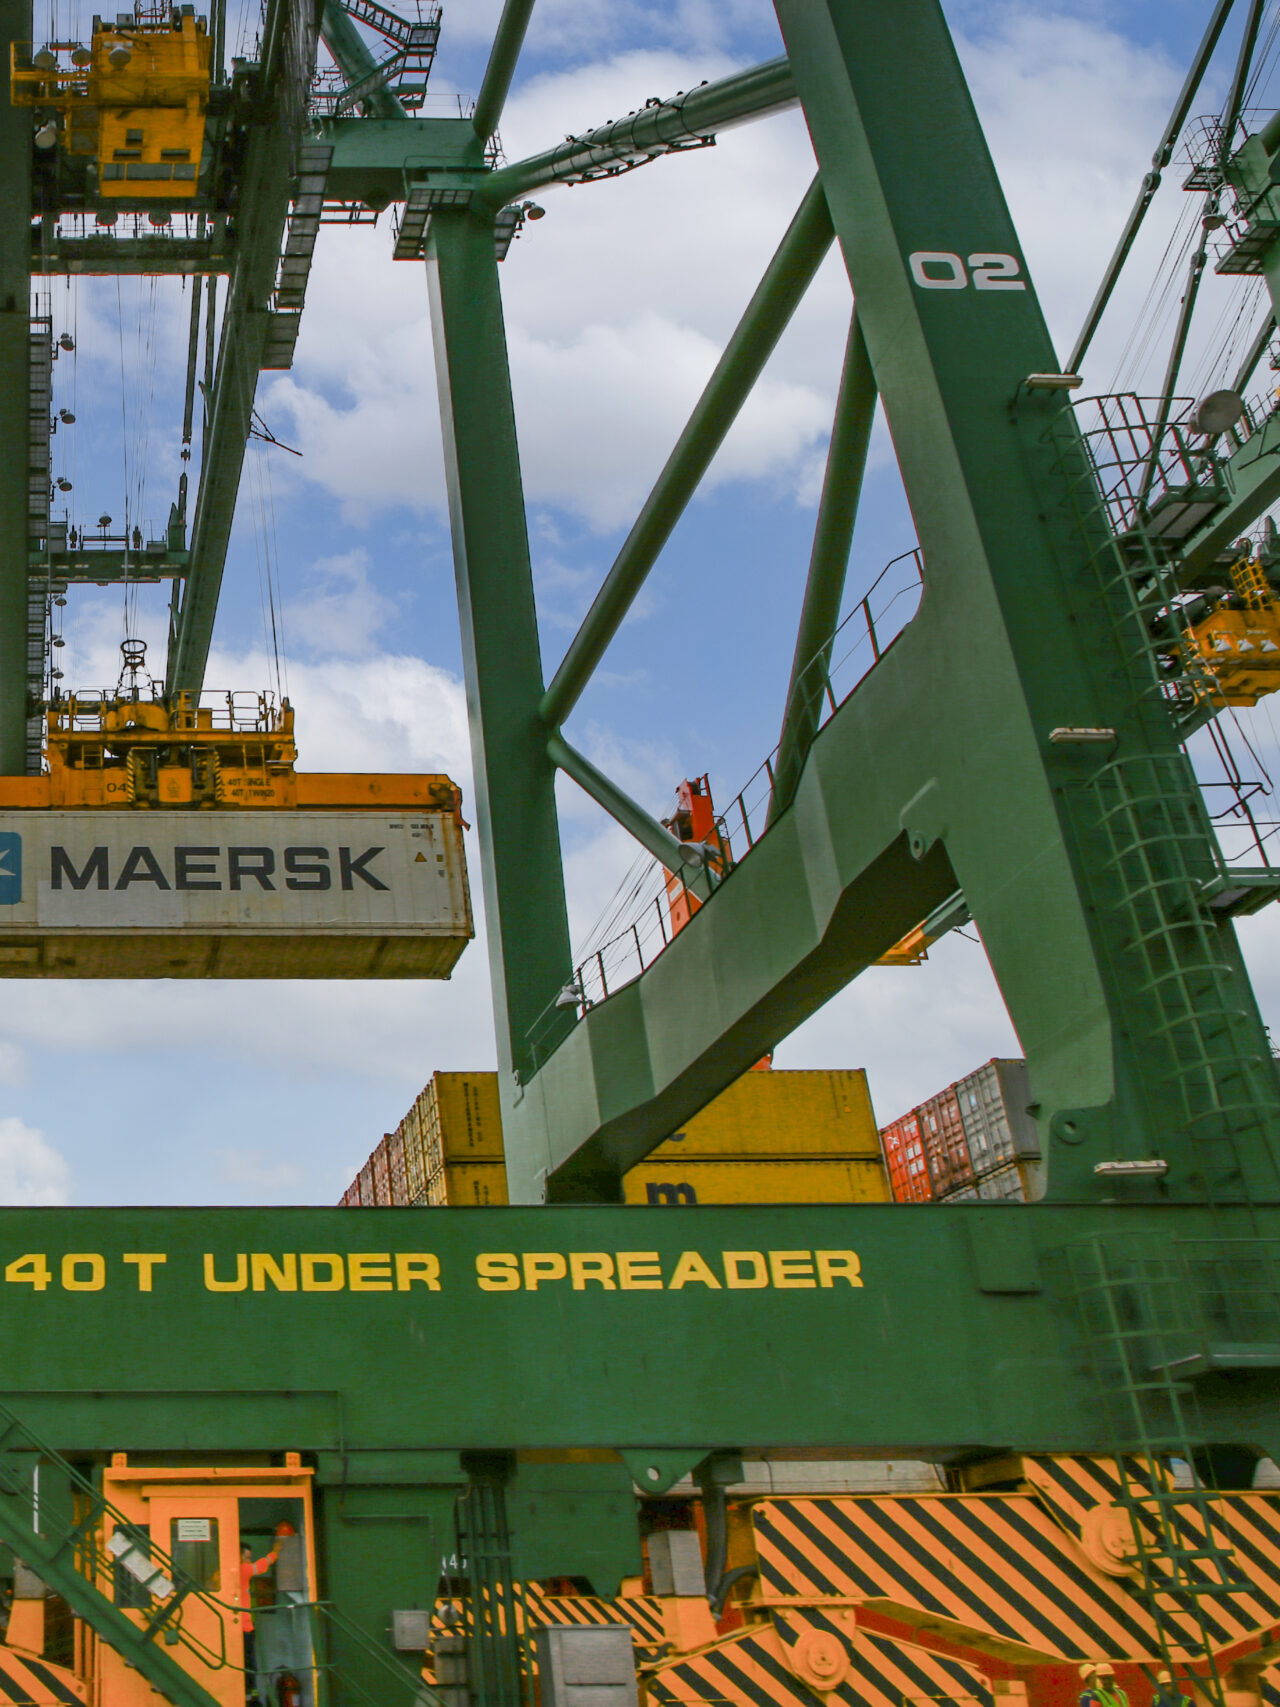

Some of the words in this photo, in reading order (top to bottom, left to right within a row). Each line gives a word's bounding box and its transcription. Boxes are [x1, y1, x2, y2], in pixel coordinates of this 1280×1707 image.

[909, 251, 1026, 290] 02
[51, 846, 391, 891] MAERSK
[203, 1253, 442, 1292] UNDER
[476, 1250, 864, 1291] SPREADER
